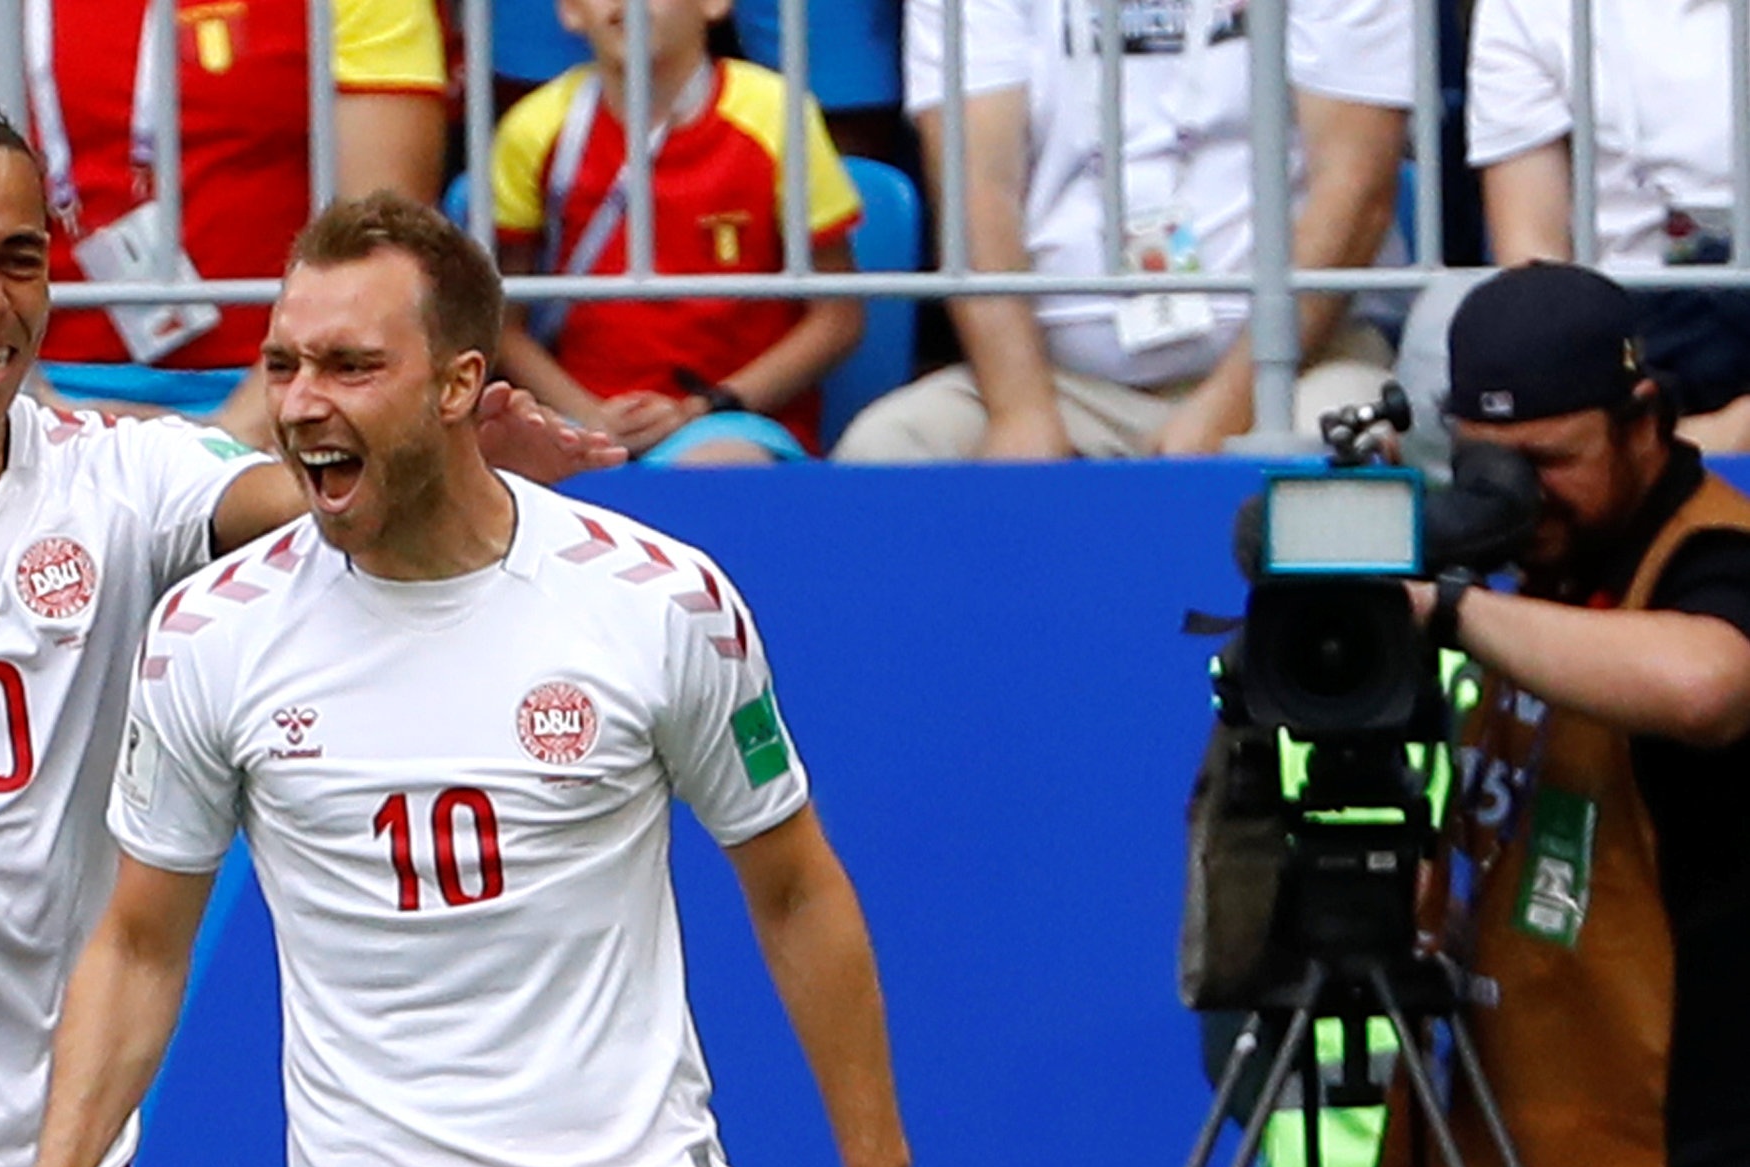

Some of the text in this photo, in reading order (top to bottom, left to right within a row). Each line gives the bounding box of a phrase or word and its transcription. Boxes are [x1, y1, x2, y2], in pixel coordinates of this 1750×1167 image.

[30, 560, 81, 597] DBU
[533, 708, 582, 736] DBU
[372, 786, 505, 912] 10
